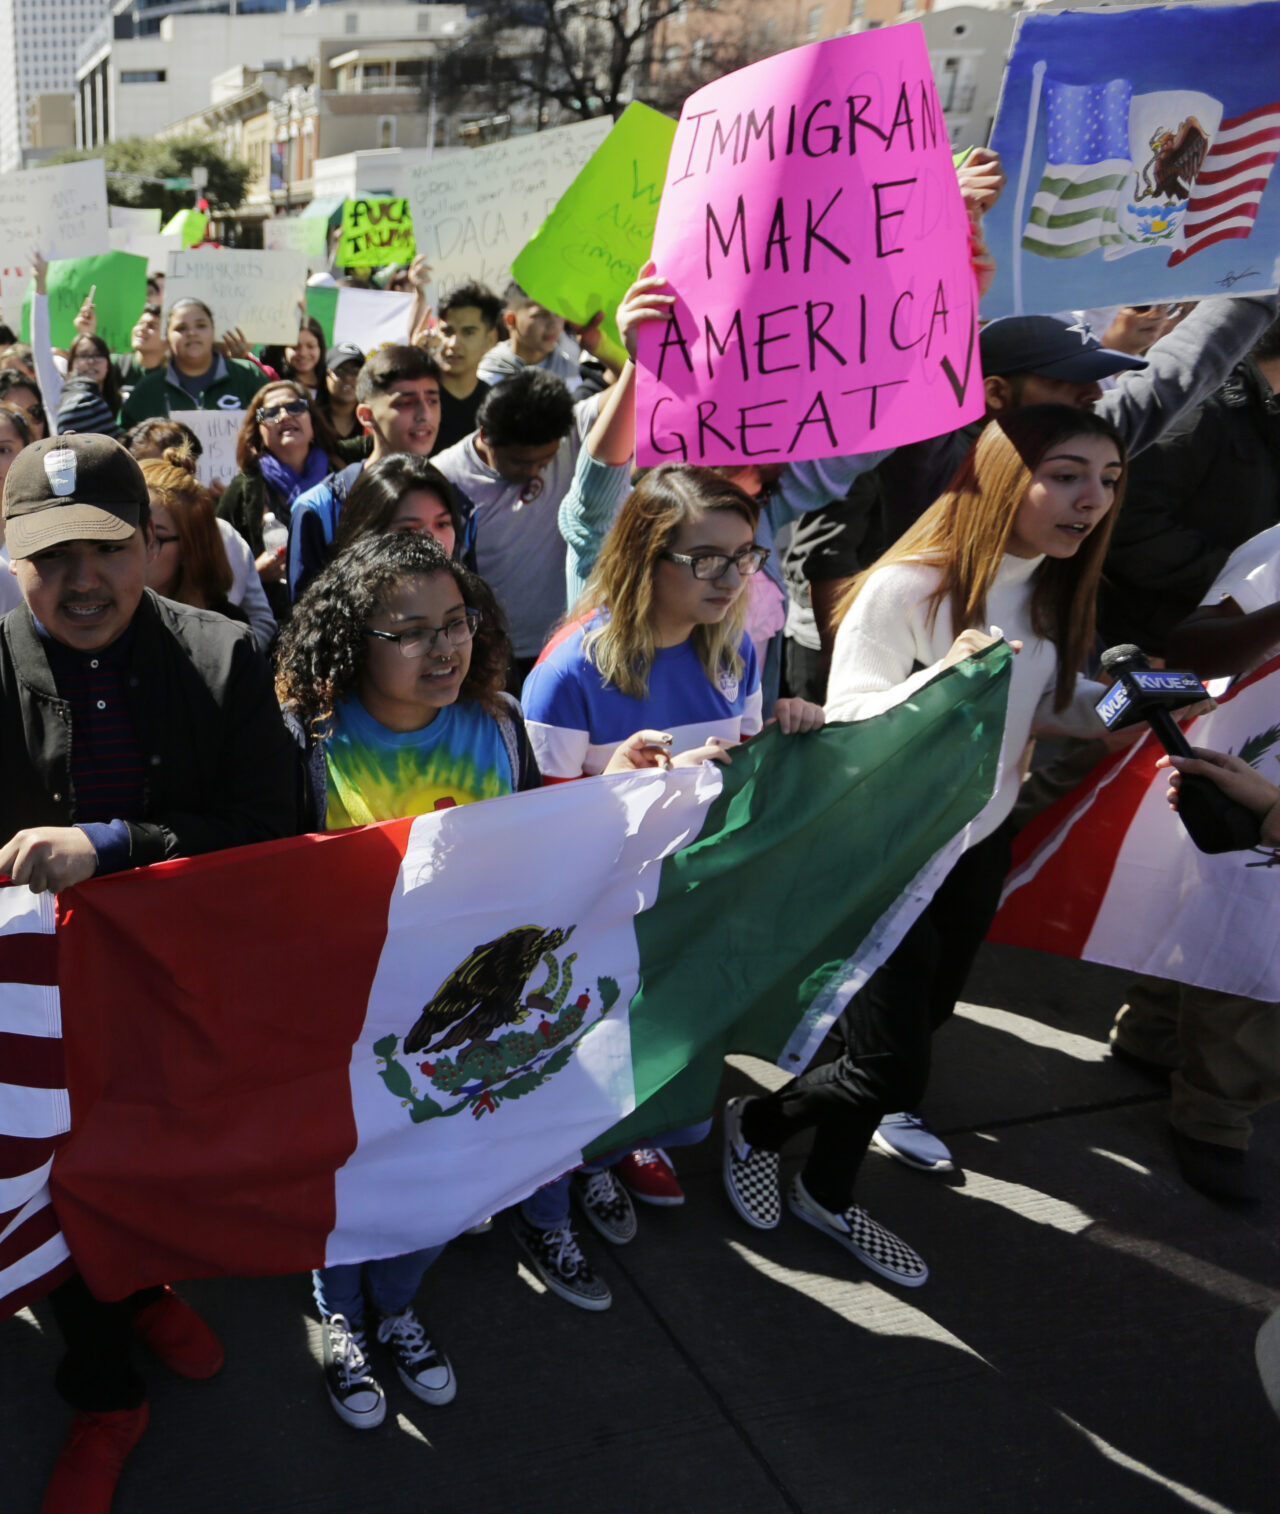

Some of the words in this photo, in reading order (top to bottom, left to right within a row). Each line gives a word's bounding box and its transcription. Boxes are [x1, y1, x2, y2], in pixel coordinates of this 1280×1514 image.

[671, 80, 948, 186] IMMIGRAN
[705, 178, 917, 280] MAKE
[656, 279, 949, 383] AMERICA
[649, 380, 909, 462] GREAT
[1096, 690, 1128, 723] KVUE
[1134, 674, 1187, 690] KVUE
